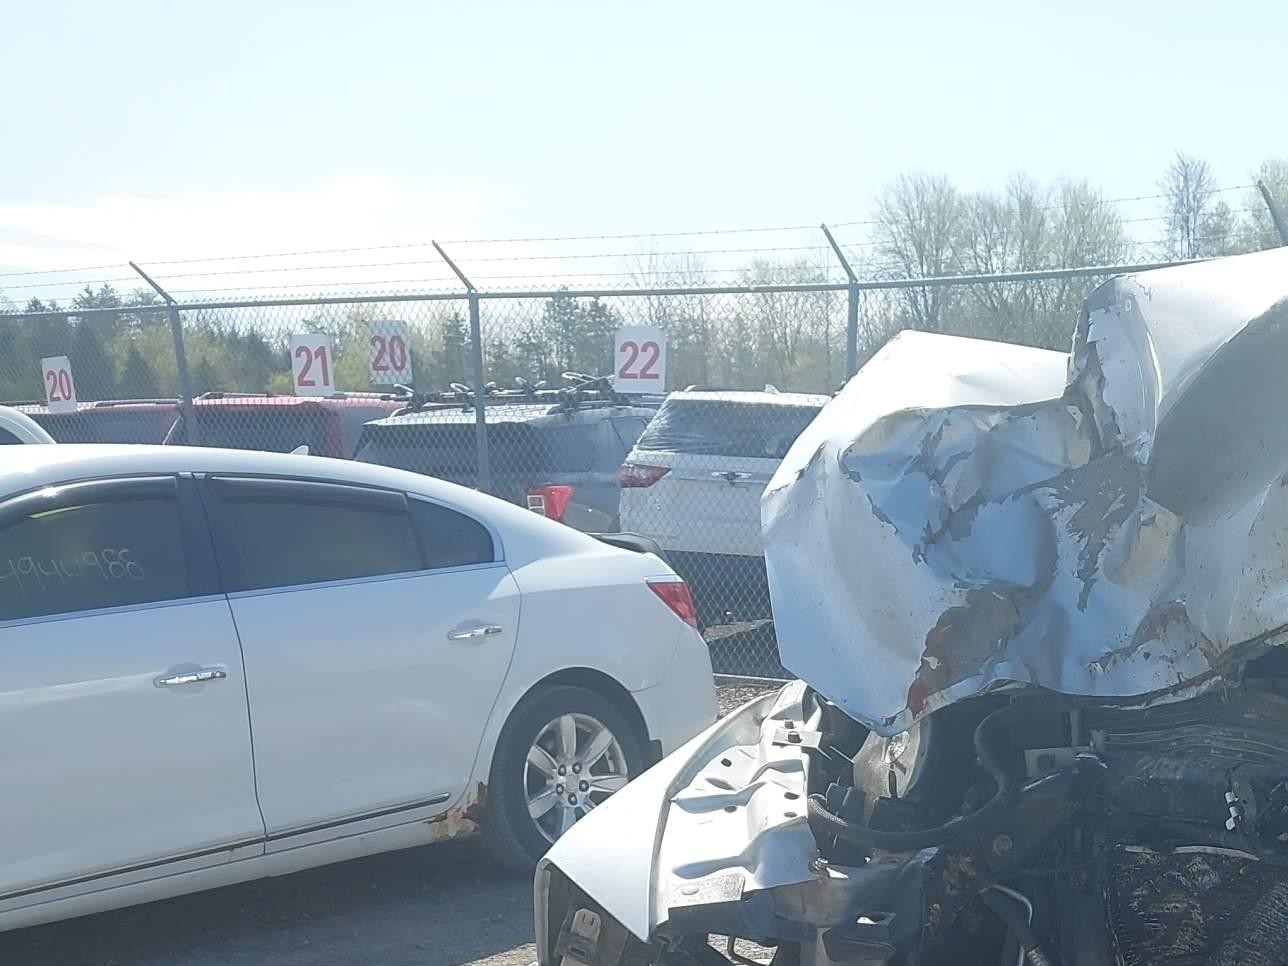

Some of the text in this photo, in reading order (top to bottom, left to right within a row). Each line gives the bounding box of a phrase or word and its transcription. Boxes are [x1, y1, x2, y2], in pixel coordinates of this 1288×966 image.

[294, 344, 332, 387] 21
[370, 333, 408, 373] 20
[618, 340, 662, 381] 22
[45, 368, 73, 402] 20
